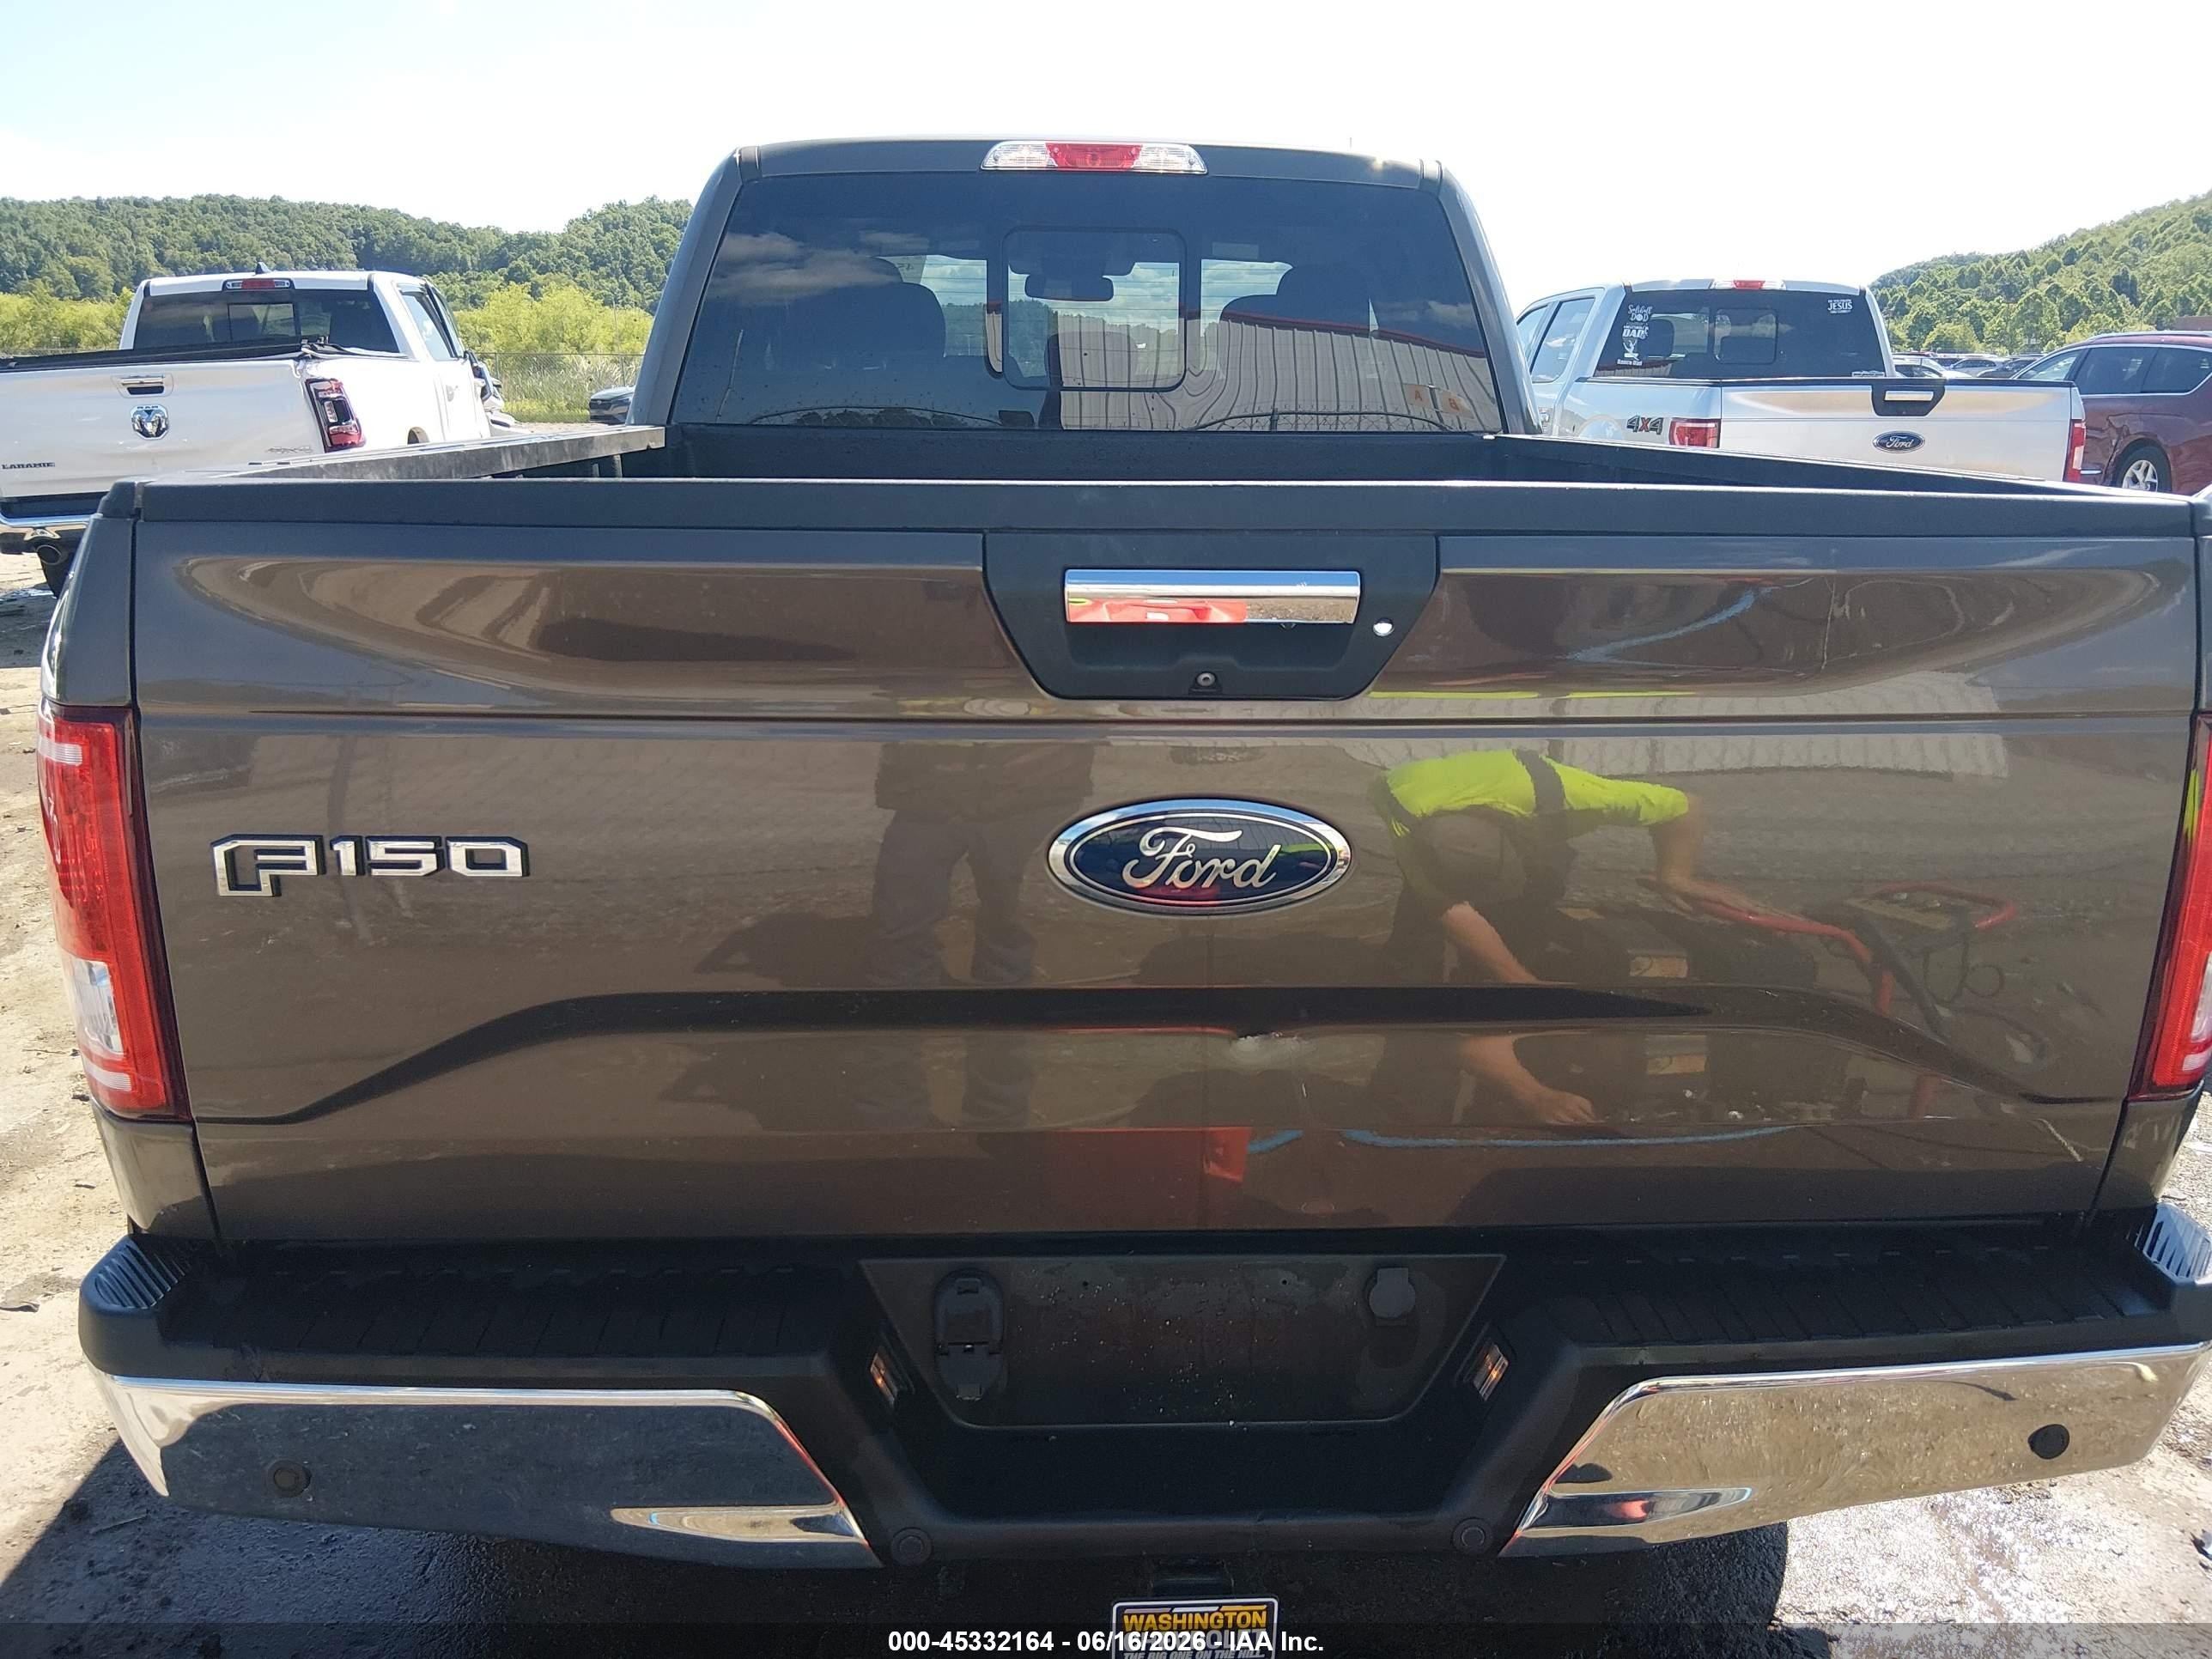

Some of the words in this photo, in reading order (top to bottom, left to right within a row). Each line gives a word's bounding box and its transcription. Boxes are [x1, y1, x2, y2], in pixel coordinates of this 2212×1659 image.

[1827, 301, 1853, 310] JESUS
[1886, 435, 1914, 448] Ford
[1122, 826, 1282, 890] Ford
[1123, 1611, 1267, 1632] WASHINGTON
[1124, 1628, 1267, 1651] CVOLET
[1169, 1650, 1194, 1659] ONE
[1194, 1650, 1212, 1659] ON
[1214, 1650, 1236, 1659] THE
